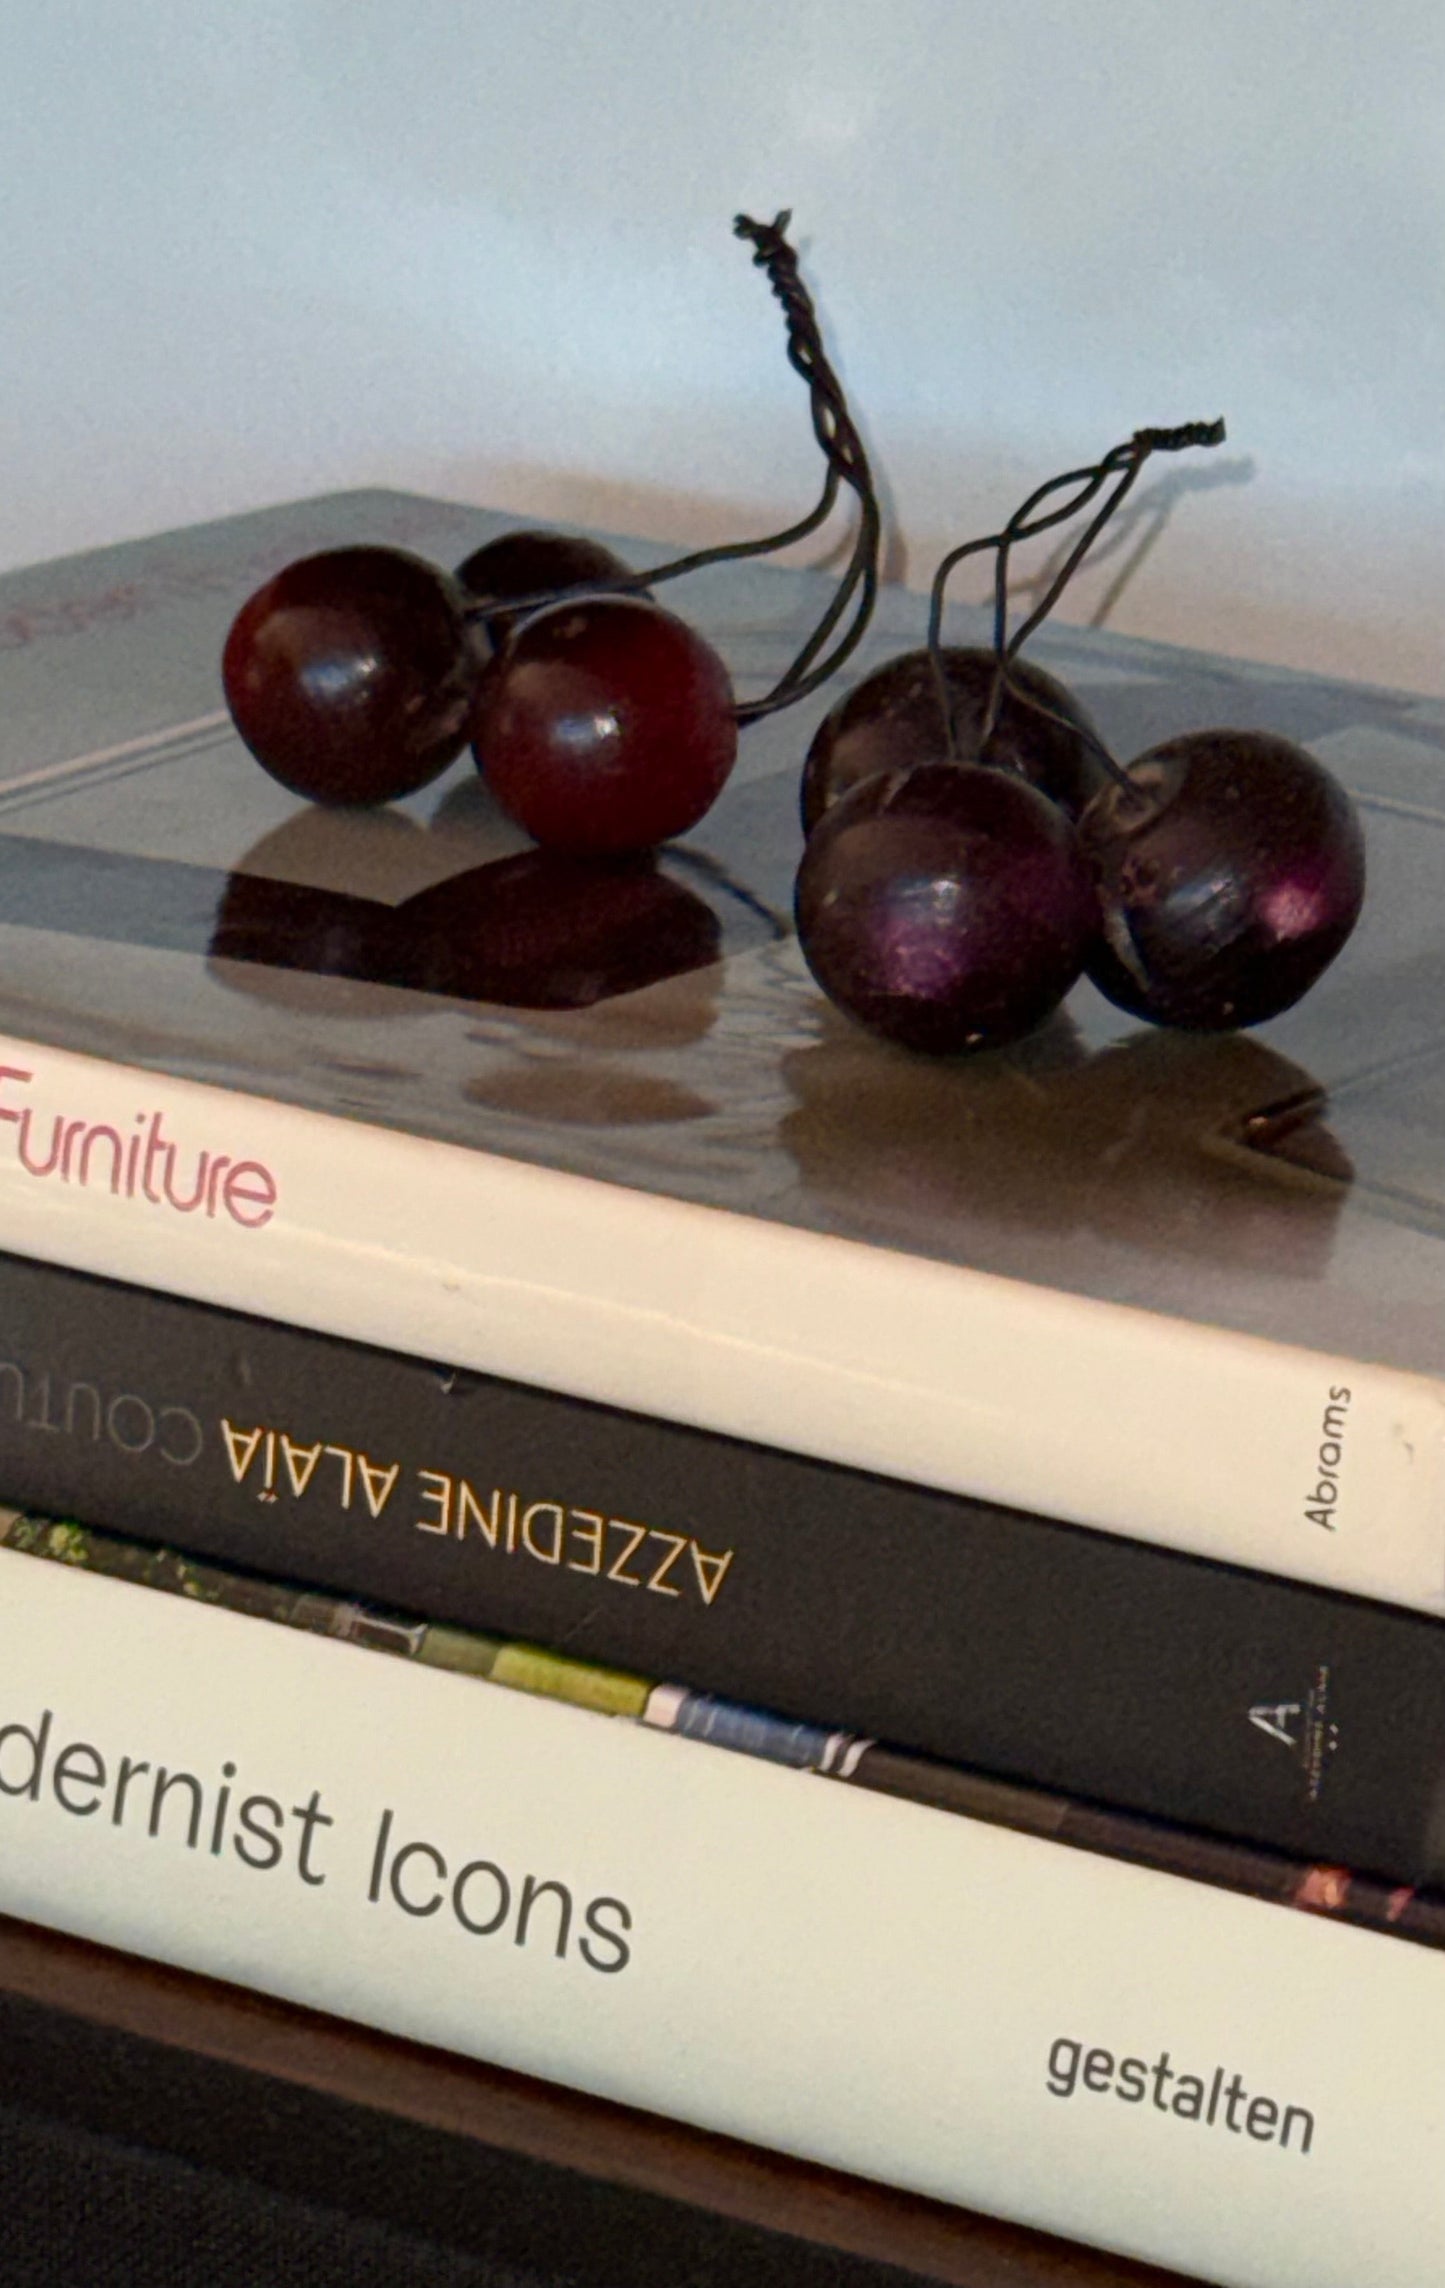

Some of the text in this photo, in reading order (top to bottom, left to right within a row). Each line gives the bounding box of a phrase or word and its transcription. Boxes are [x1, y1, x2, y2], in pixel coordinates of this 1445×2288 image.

[220, 1418, 400, 1518] ALAÏA
[1303, 1385, 1352, 1532] Abrams
[415, 1470, 734, 1605] AZZEDINE
[367, 1808, 633, 1974] Icons
[1046, 2037, 1315, 2154] gestalten
